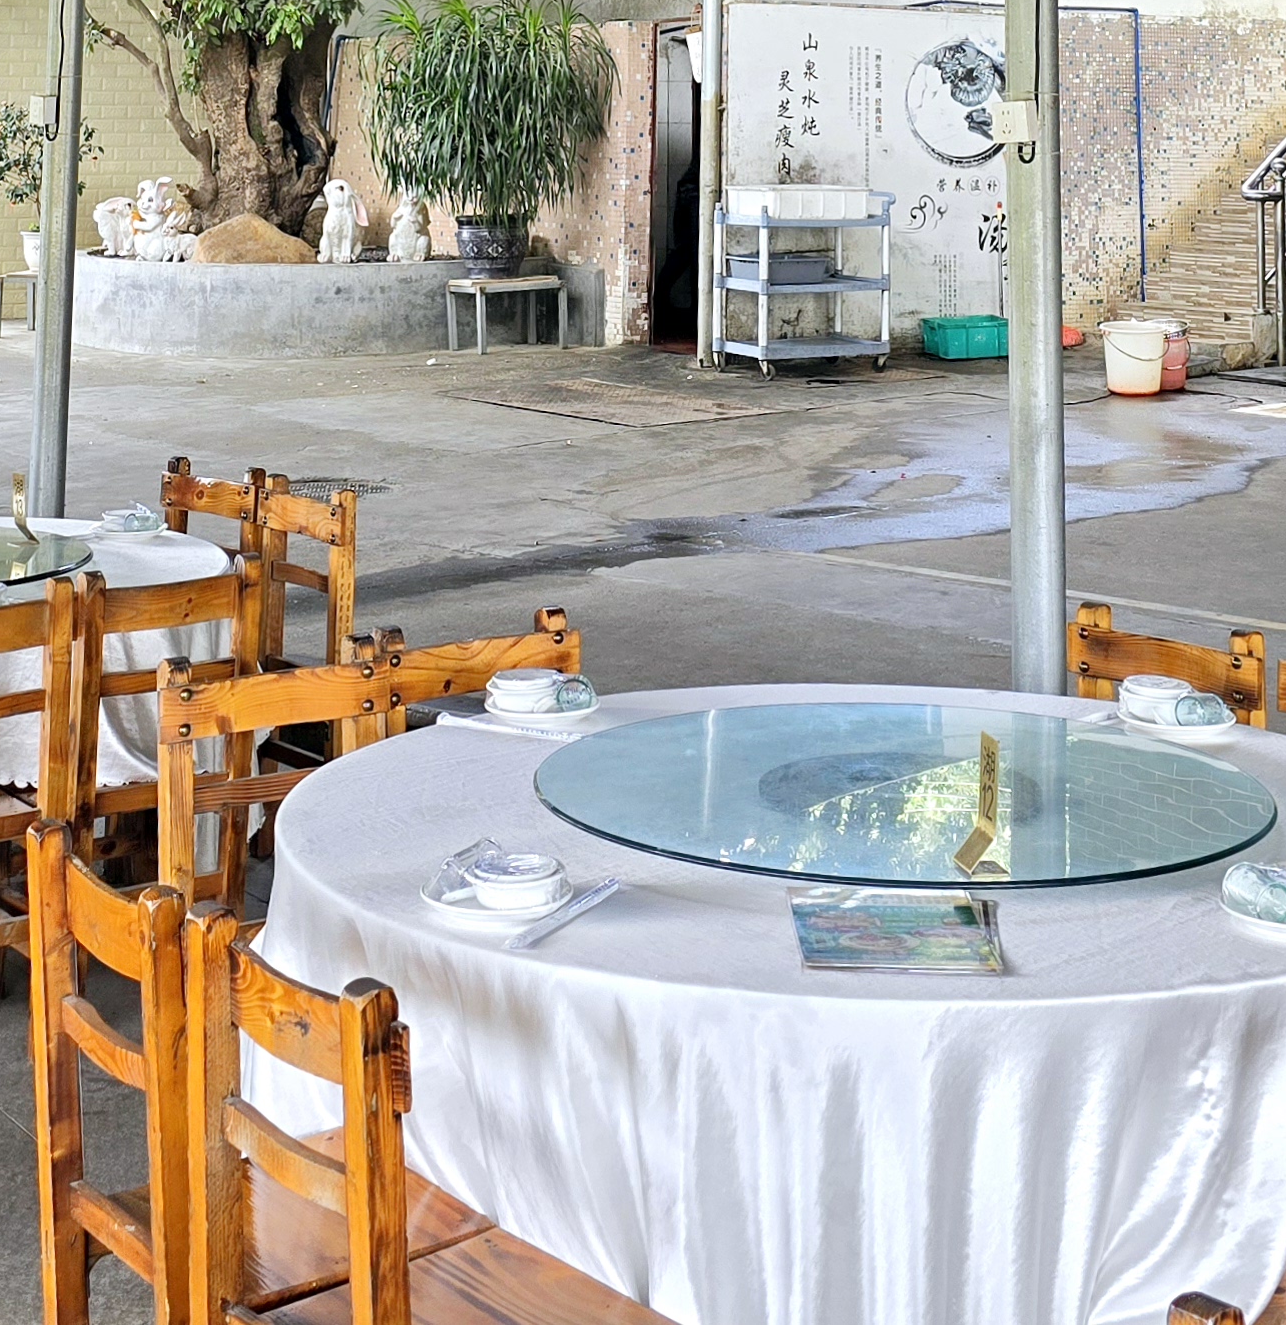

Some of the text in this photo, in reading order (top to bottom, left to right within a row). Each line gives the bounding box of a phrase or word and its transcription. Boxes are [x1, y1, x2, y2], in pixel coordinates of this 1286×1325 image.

[775, 70, 794, 177] 灵芝瘦肉
[801, 32, 820, 136] 山泉水炖
[937, 178, 998, 193] 营养温补
